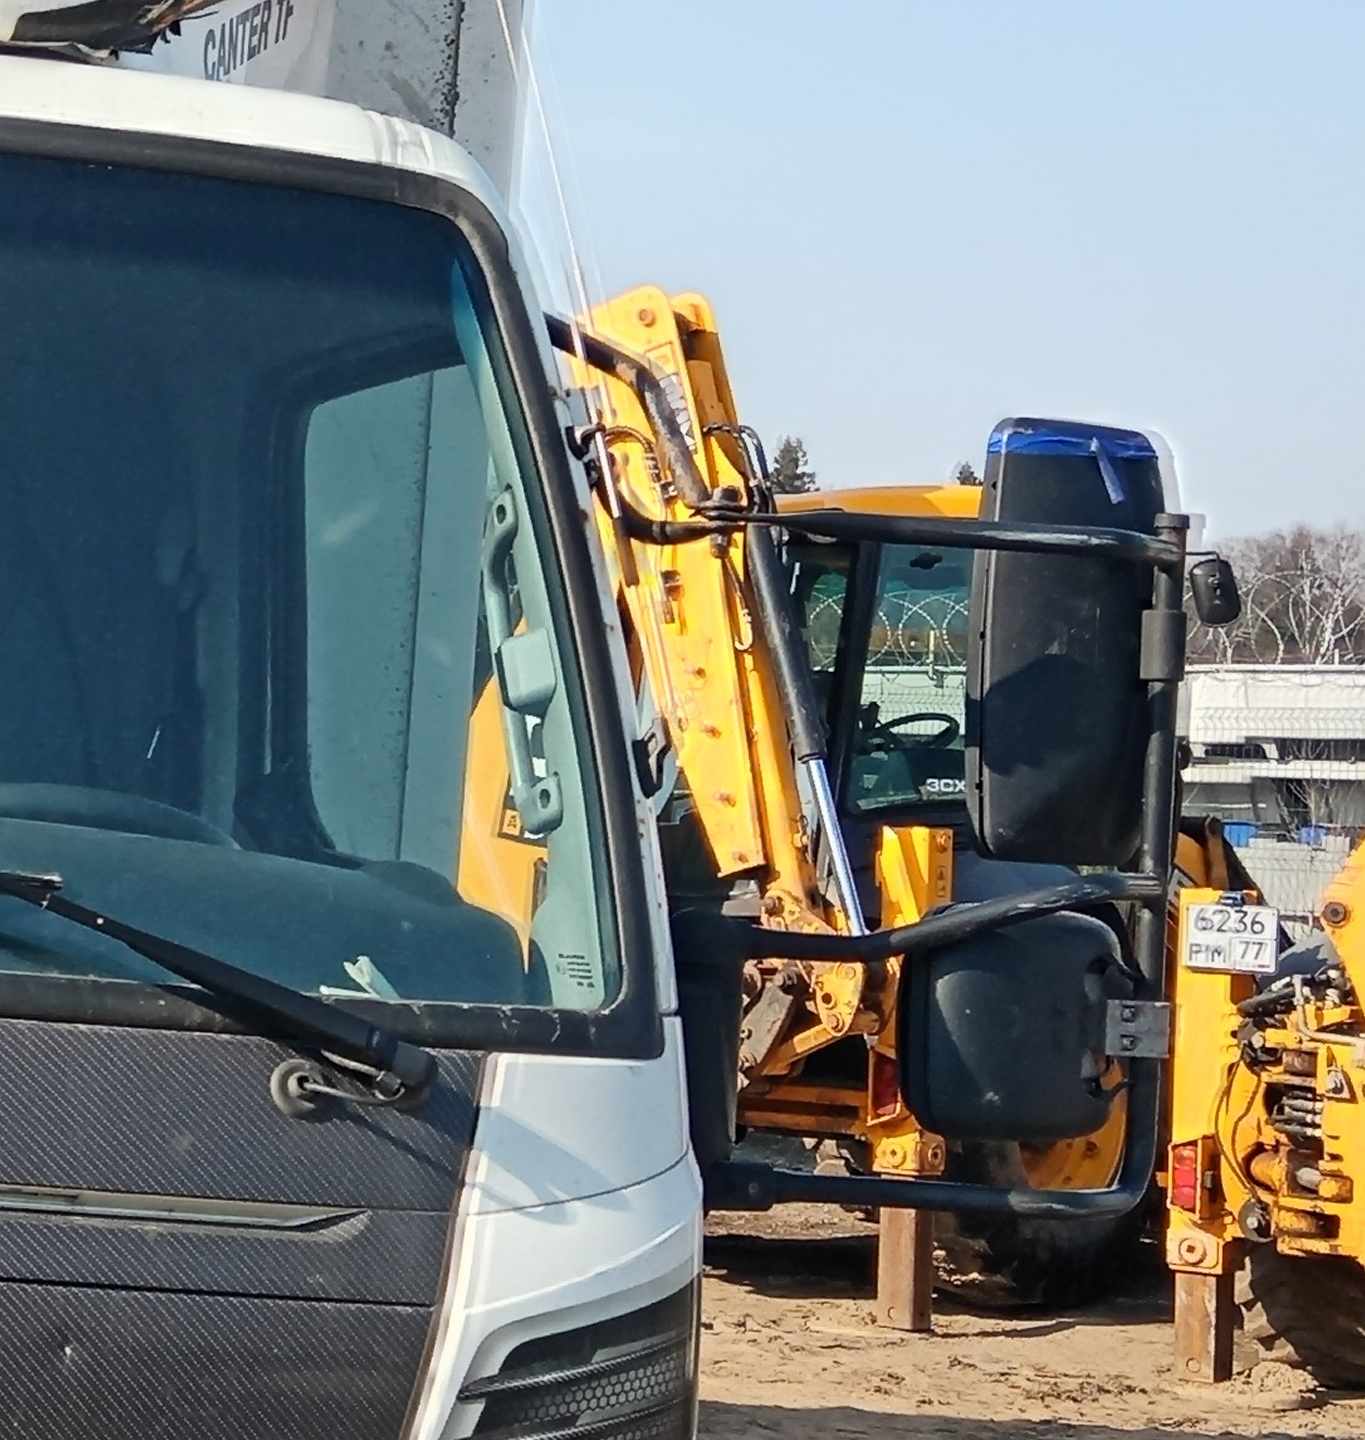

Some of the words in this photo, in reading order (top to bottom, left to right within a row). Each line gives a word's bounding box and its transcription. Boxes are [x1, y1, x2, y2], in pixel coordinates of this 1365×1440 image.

[926, 778, 966, 792] 3CX
[1194, 908, 1266, 935] 6236
[1238, 940, 1268, 961] 77
